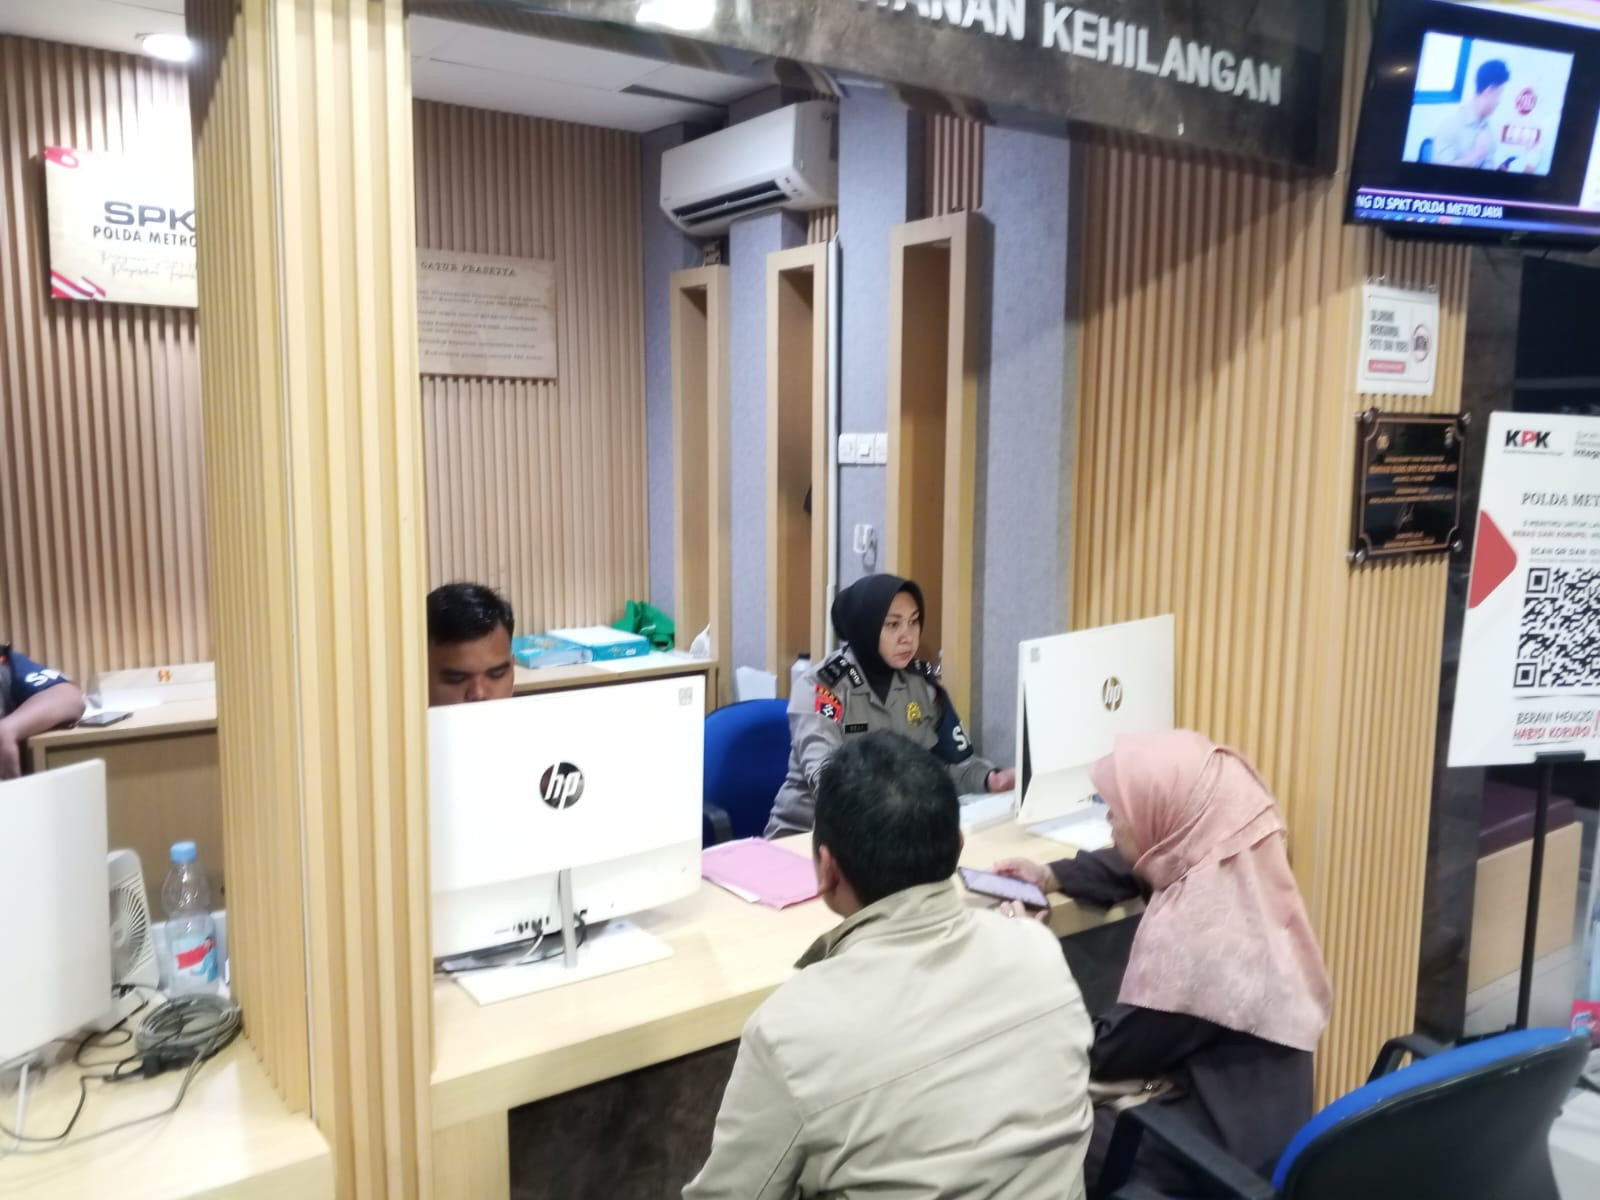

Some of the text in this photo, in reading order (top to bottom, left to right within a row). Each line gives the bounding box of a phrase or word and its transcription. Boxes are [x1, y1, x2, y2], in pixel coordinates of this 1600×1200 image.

[1042, 1, 1282, 106] KEHILANGAN
[104, 200, 195, 232] SPK
[1373, 196, 1385, 209] DI
[1385, 196, 1412, 211] SPKT
[1412, 199, 1445, 214] POLDA
[1446, 202, 1481, 217] METRO
[1482, 205, 1503, 218] JAYA
[93, 225, 142, 242] POLDA
[1505, 429, 1552, 449] KPK
[1520, 491, 1568, 507] POLDA
[1102, 676, 1124, 713] hp
[540, 762, 584, 810] hp
